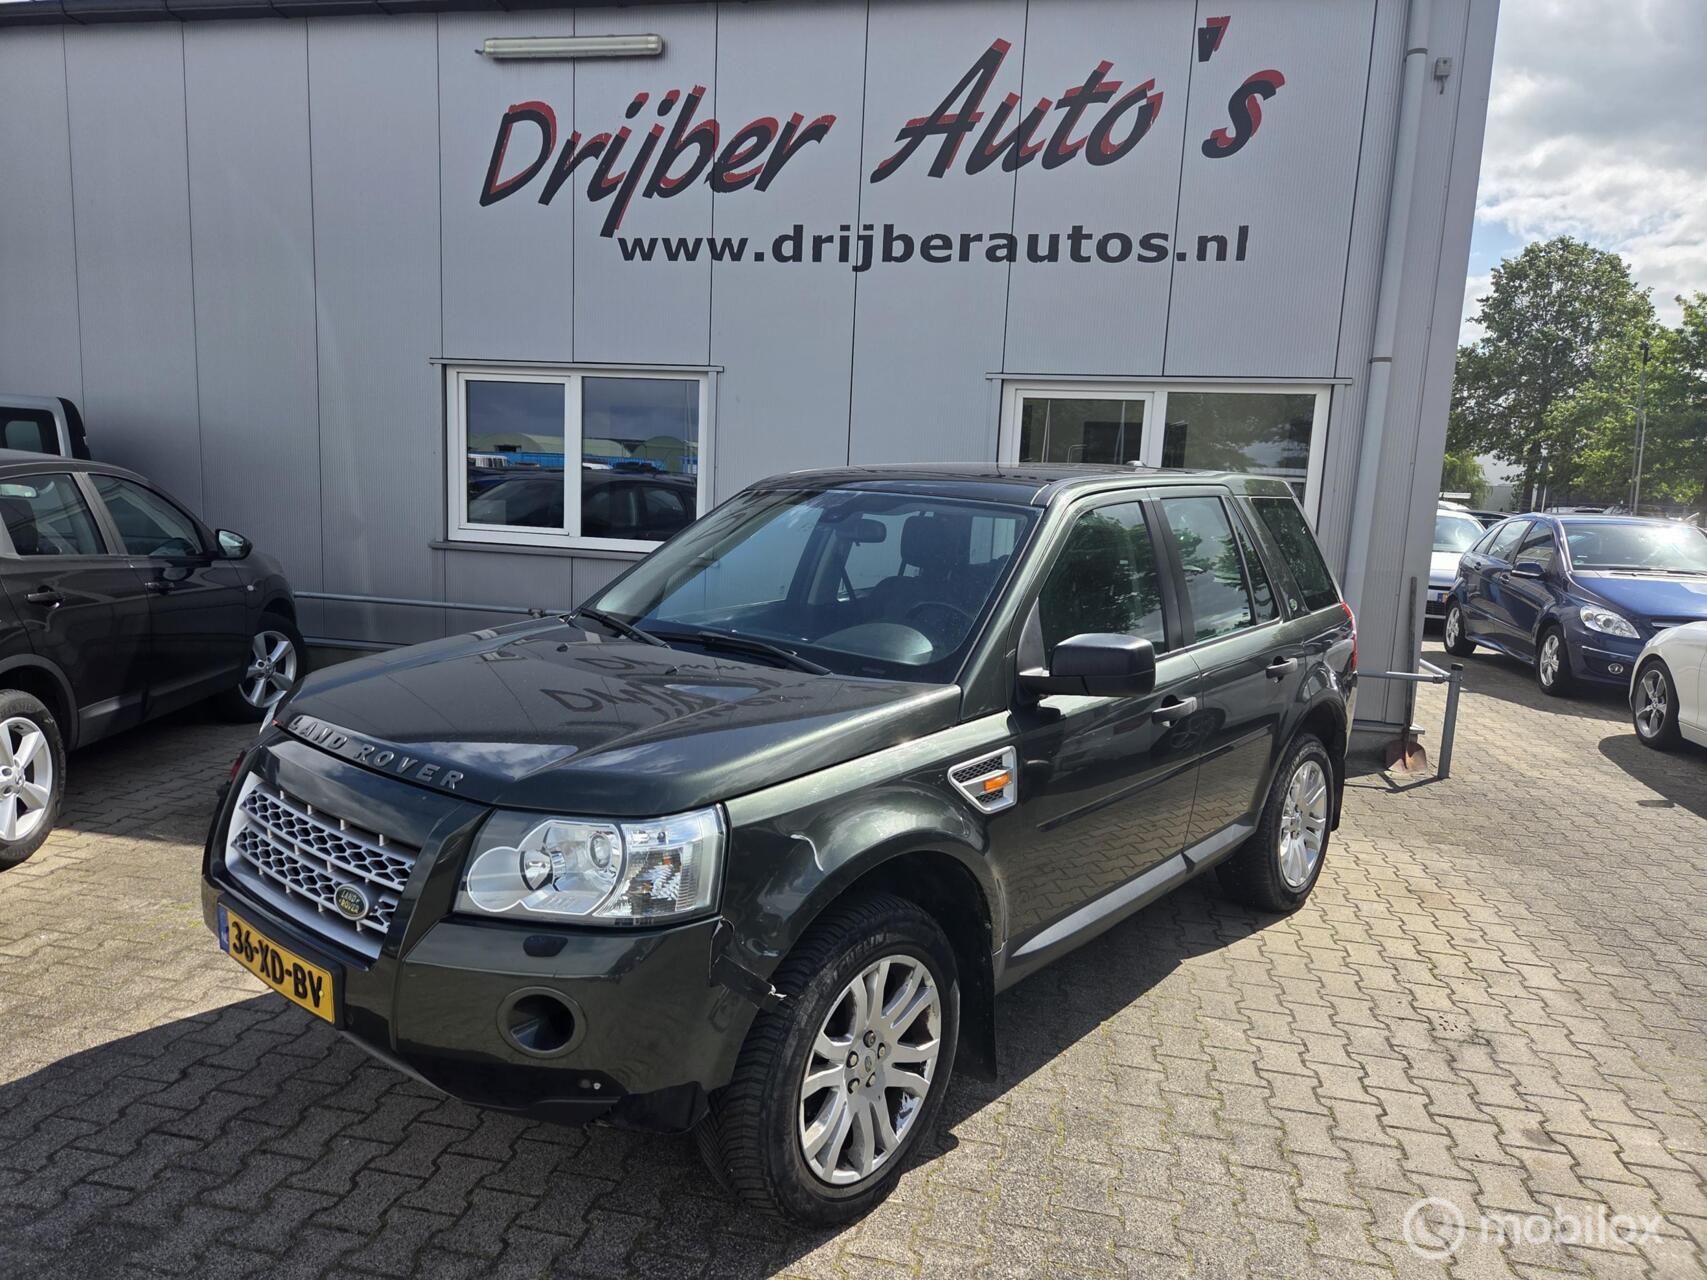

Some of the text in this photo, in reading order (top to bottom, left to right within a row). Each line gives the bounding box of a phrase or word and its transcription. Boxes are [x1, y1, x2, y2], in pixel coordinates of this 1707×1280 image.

[479, 16, 1285, 237] Drijber Auto's
[618, 224, 1249, 272] www.drijberautos.nl
[290, 716, 464, 790] LAND ROVER
[232, 921, 323, 1008] 36-XD-BV
